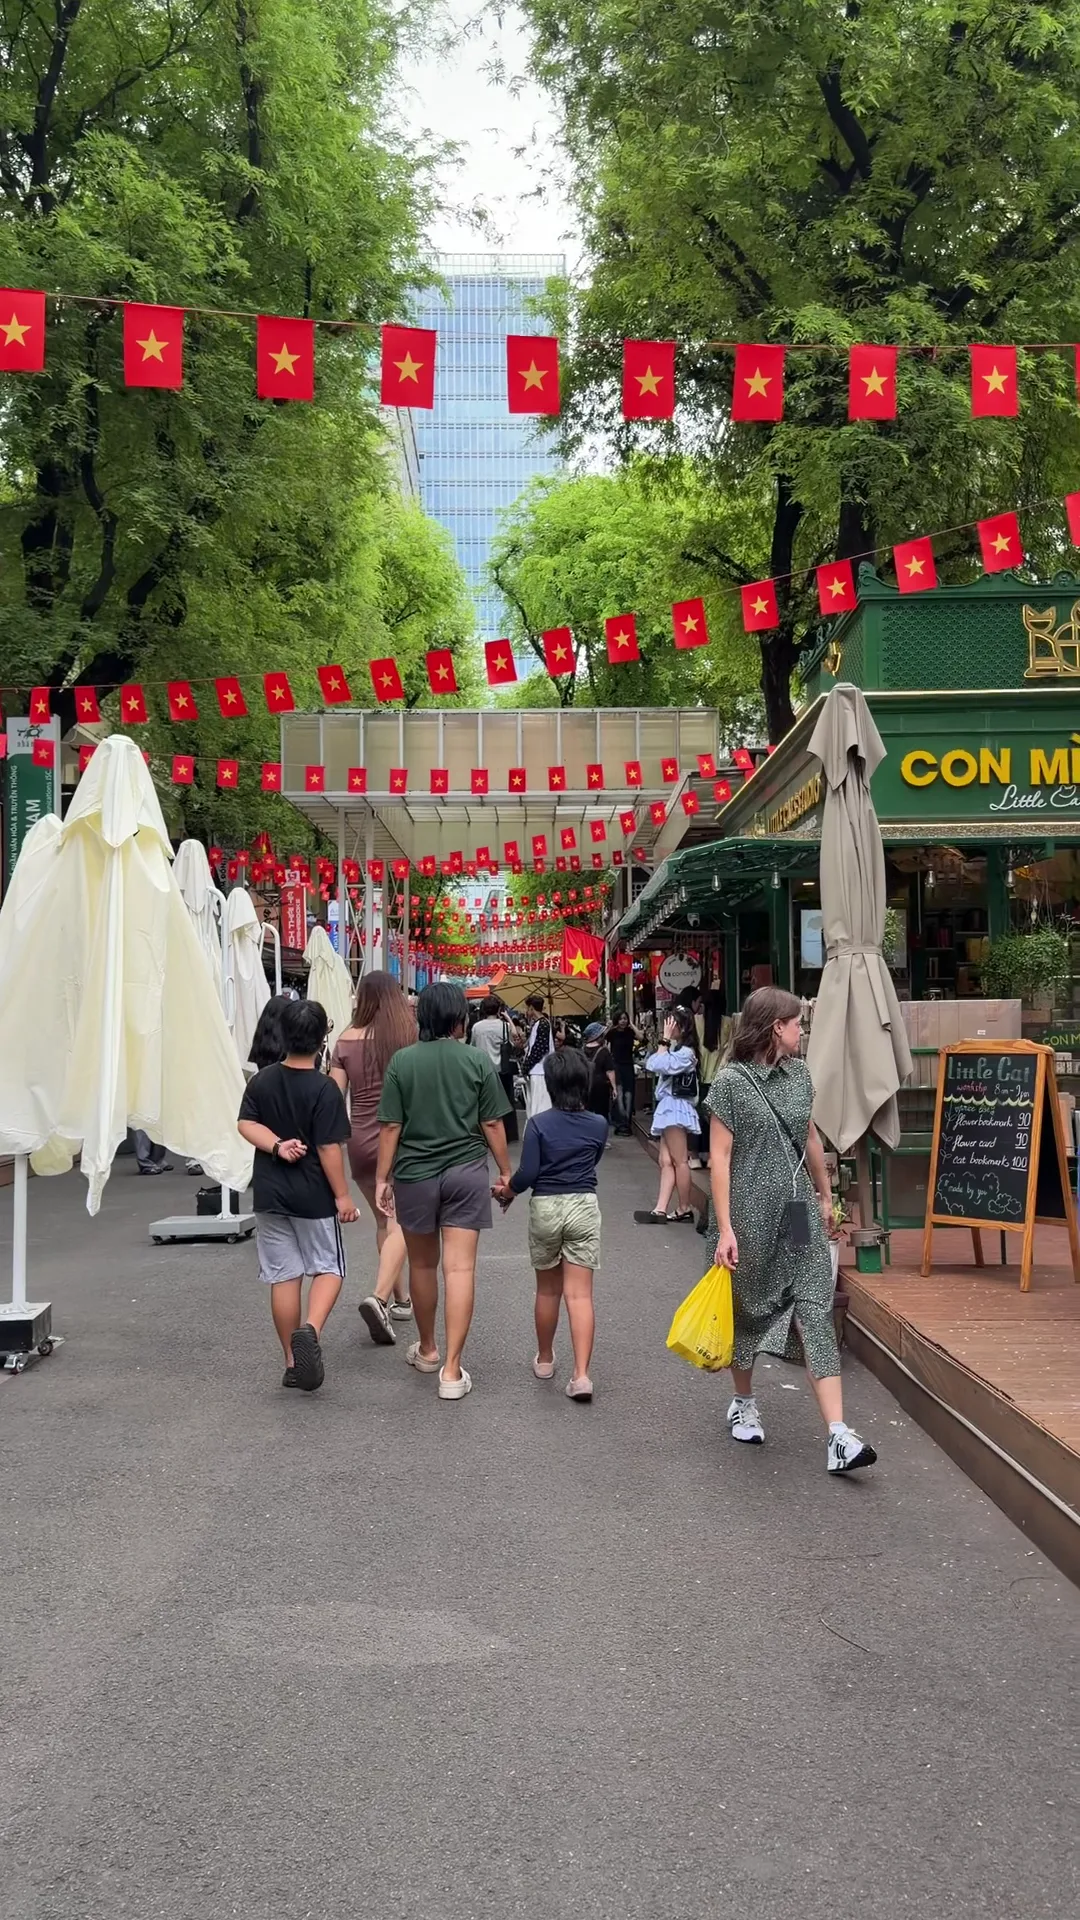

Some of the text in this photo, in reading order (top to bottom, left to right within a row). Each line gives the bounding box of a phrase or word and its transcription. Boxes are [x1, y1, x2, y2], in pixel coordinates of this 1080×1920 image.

[901, 748, 1011, 787] CON
[990, 784, 1047, 811] Little
[1043, 1034, 1068, 1046] CON
[948, 1056, 993, 1080] Little
[997, 1056, 1030, 1082] Cat
[1017, 1112, 1031, 1128] 90
[952, 1132, 1029, 1152] flower card 90
[952, 1155, 966, 1165] cat
[1012, 1156, 1028, 1168] 100
[966, 1181, 975, 1200] by
